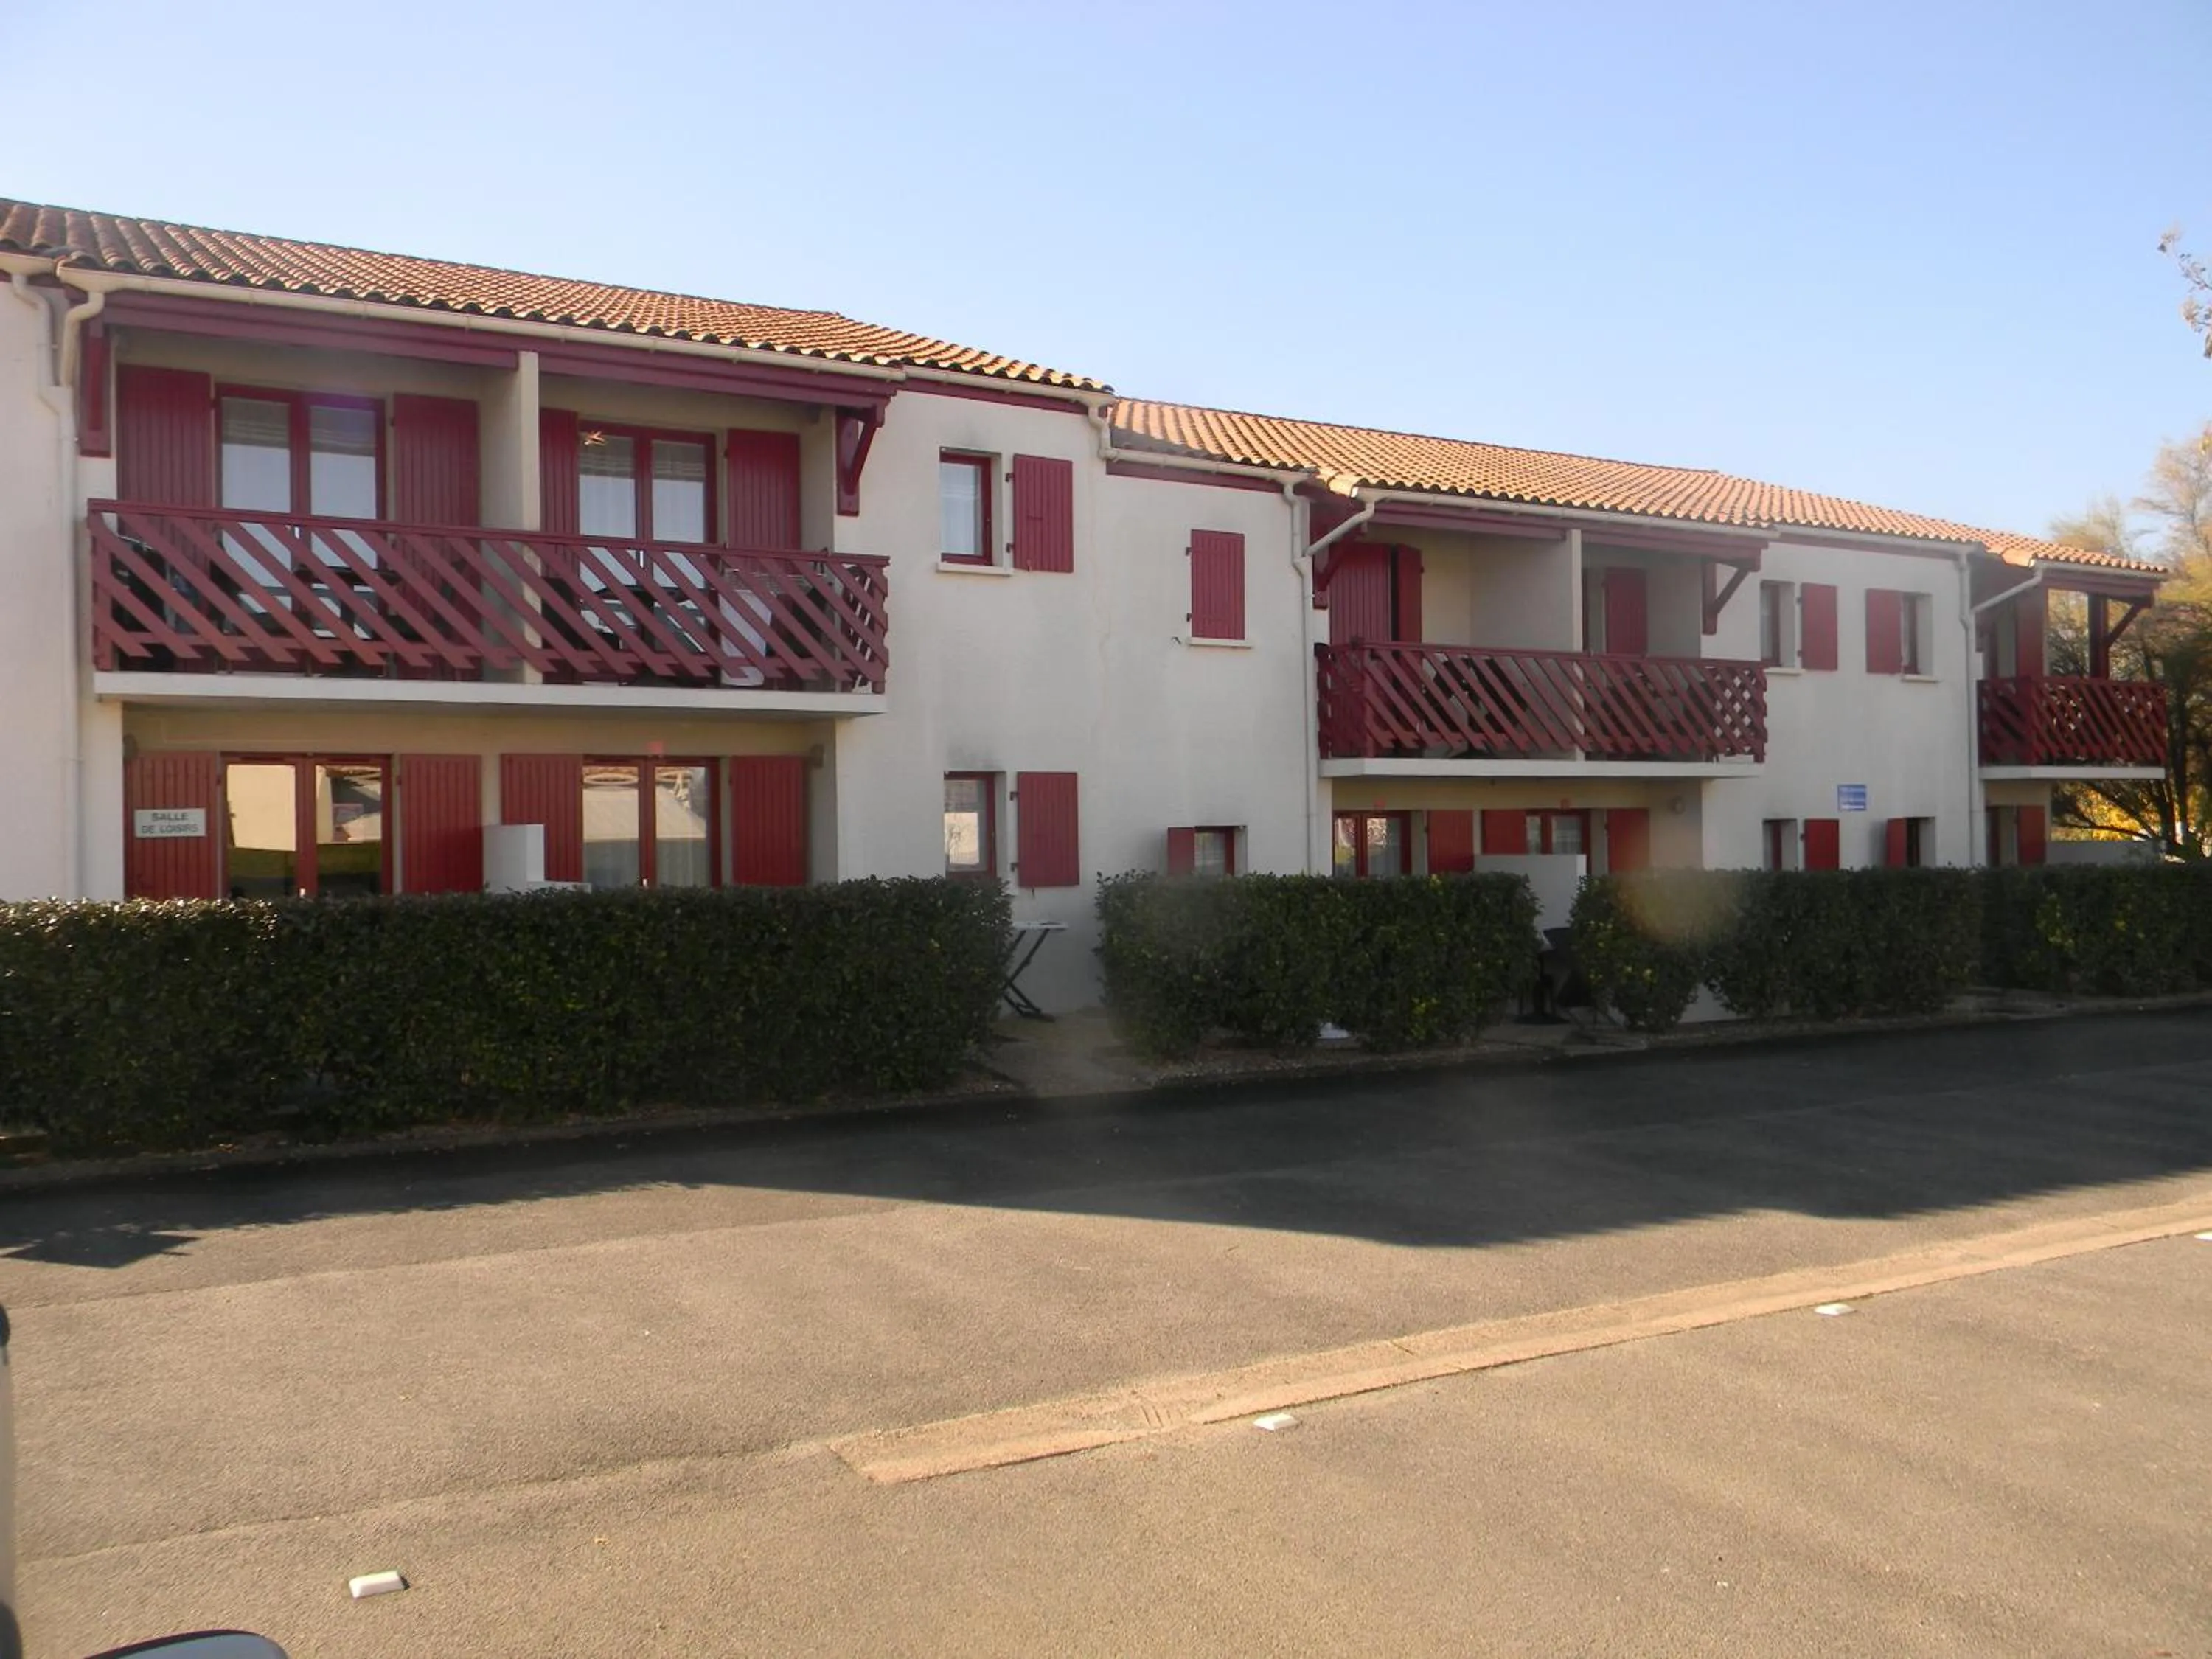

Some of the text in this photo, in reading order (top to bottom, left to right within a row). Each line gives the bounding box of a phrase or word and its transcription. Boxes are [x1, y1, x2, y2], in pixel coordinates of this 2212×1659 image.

[151, 812, 189, 821] SALLE
[141, 824, 199, 834] DE LOISIRS
